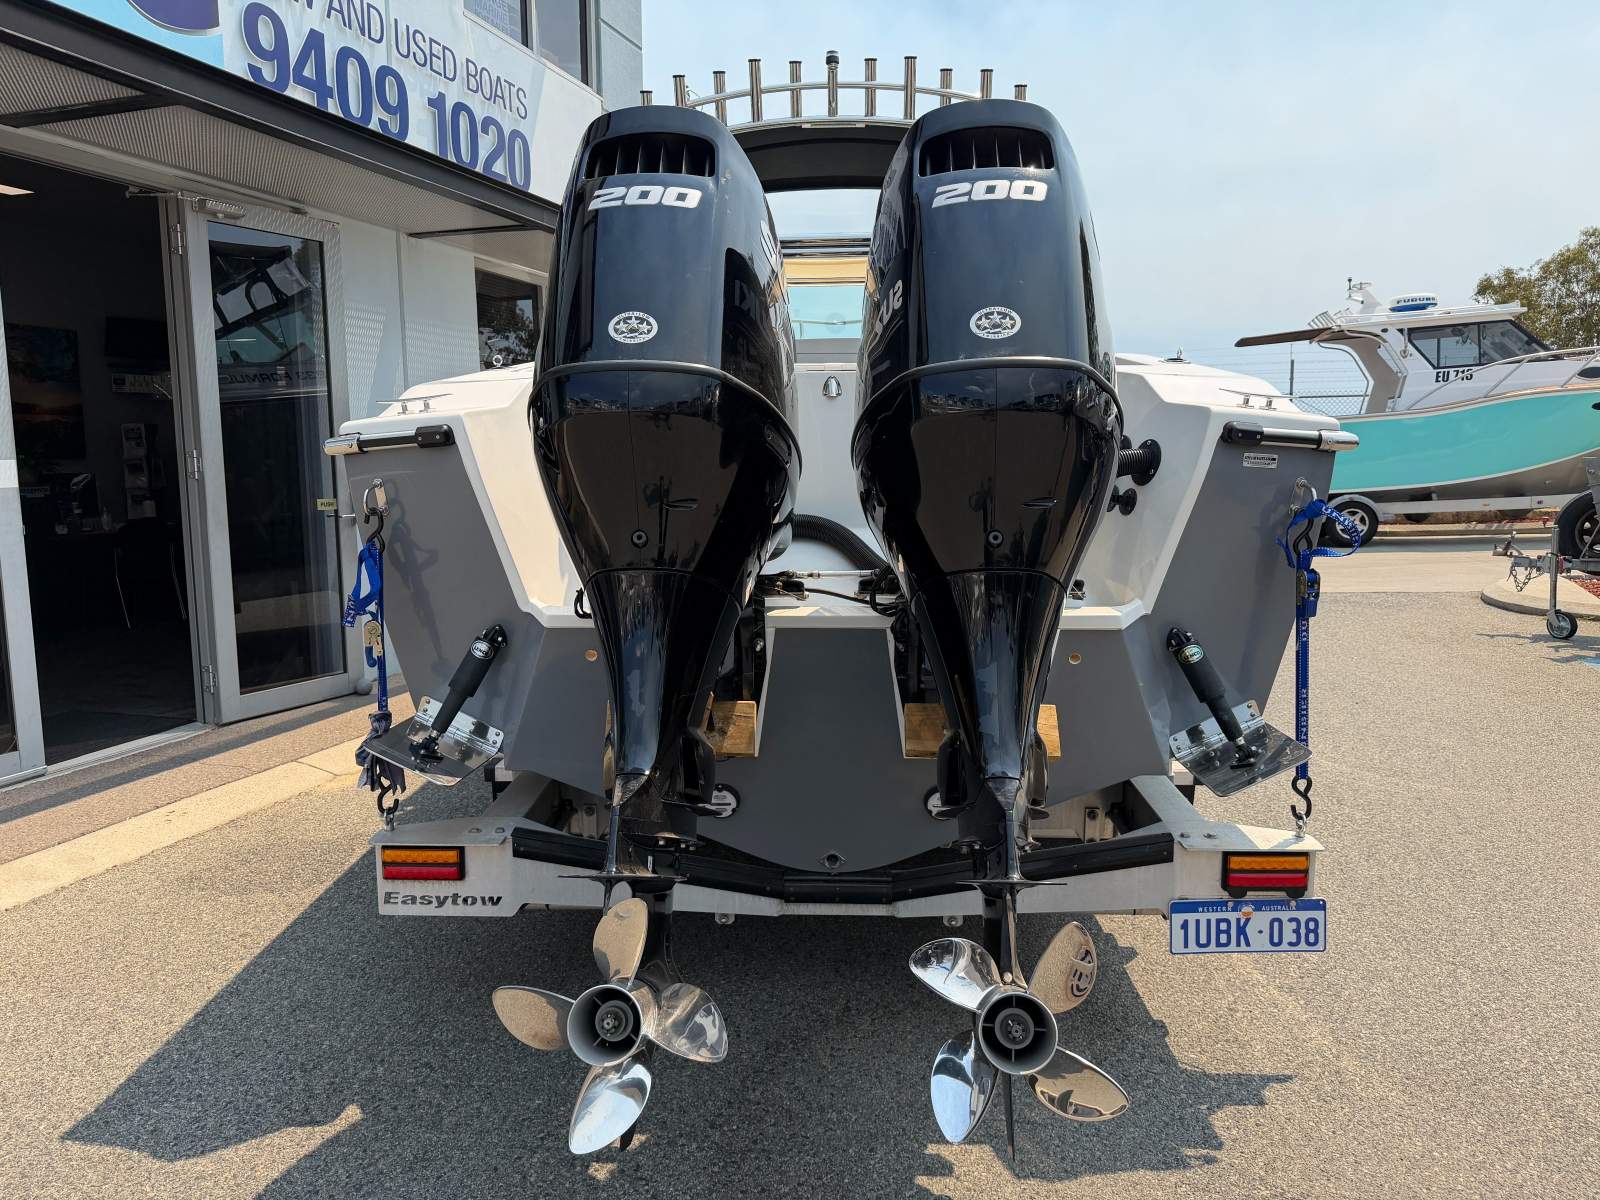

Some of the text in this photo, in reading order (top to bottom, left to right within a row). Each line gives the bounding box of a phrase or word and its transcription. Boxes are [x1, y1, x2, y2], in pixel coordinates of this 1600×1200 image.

[326, 0, 384, 44] AND
[394, 18, 457, 83] USED
[465, 57, 528, 120] BOATS
[242, 2, 531, 192] 9409 1020
[588, 185, 702, 212] 200
[931, 180, 1048, 208] 200
[1435, 371, 1450, 383] EU
[384, 891, 503, 909] Easytow
